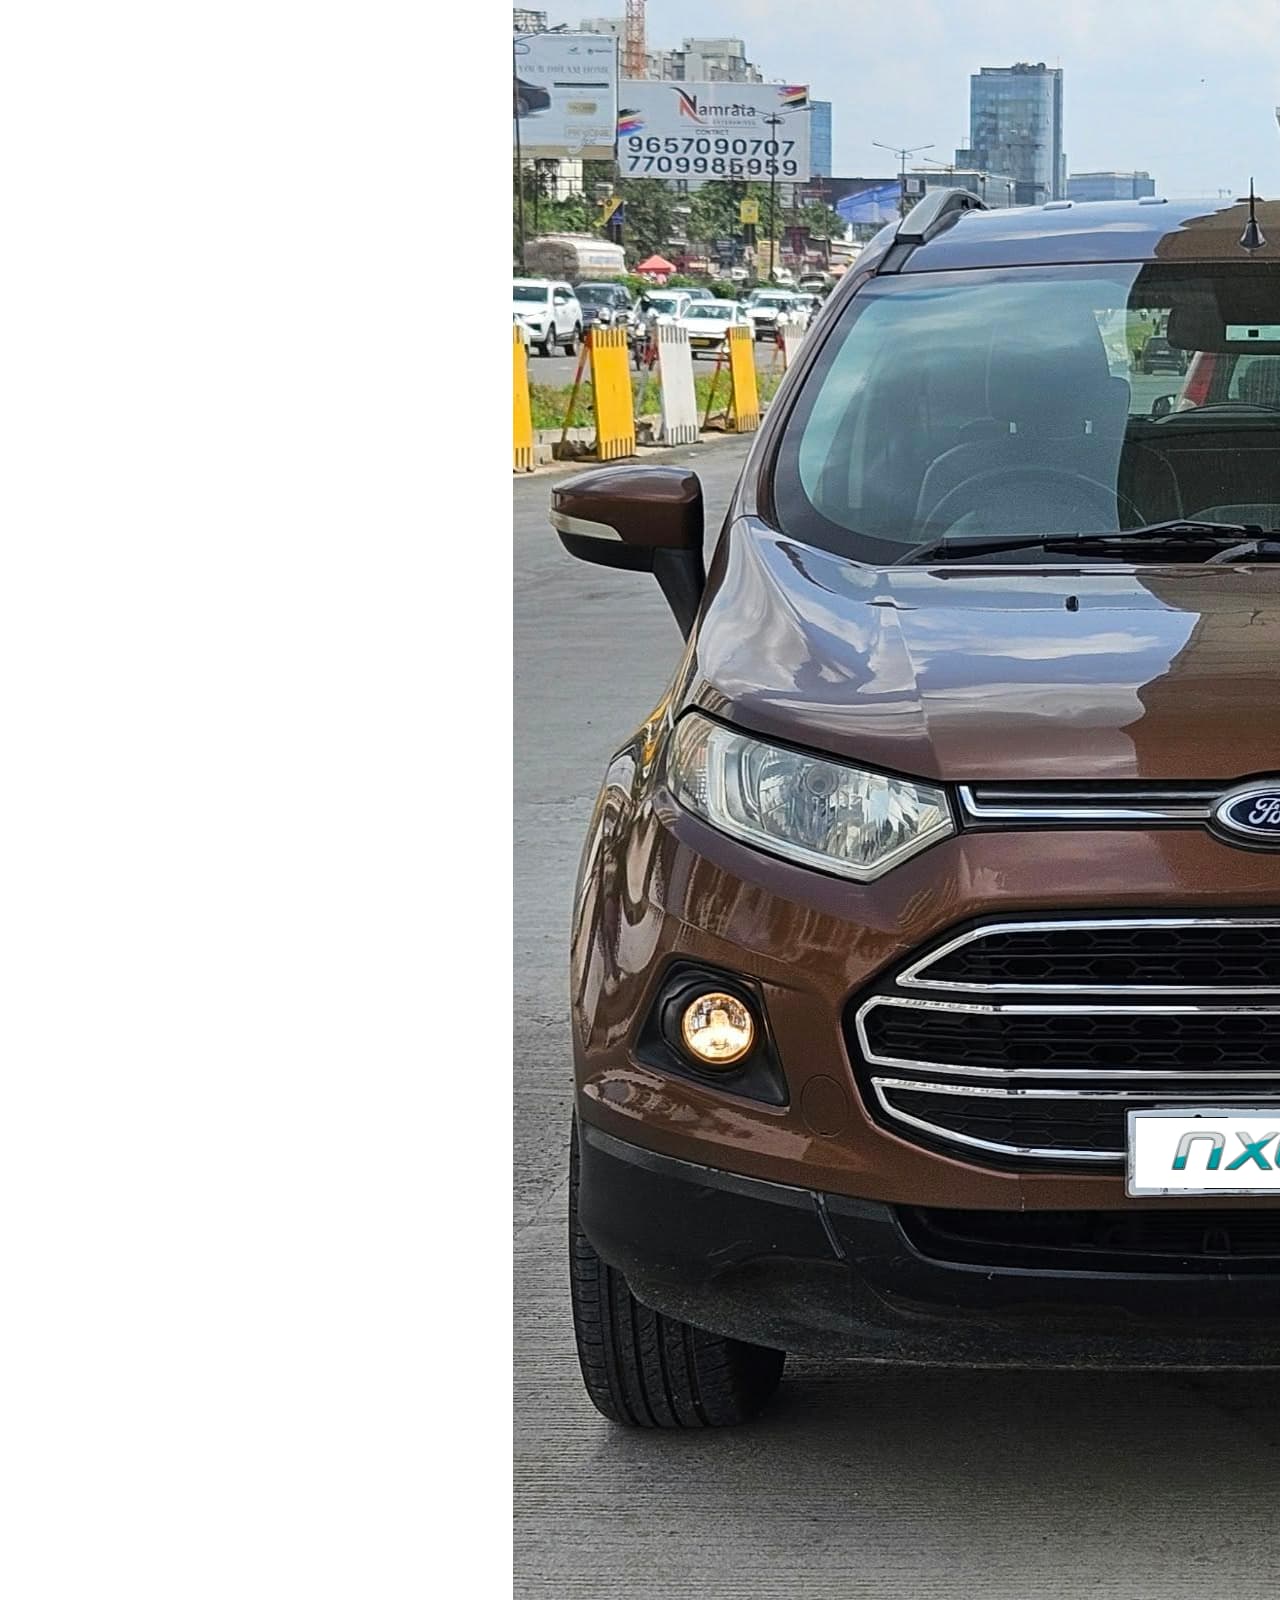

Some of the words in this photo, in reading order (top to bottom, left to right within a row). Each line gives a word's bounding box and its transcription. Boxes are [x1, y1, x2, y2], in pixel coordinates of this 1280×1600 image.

[670, 87, 756, 124] Namrata
[628, 136, 795, 157] 9657090707
[627, 155, 798, 176] 7709985959
